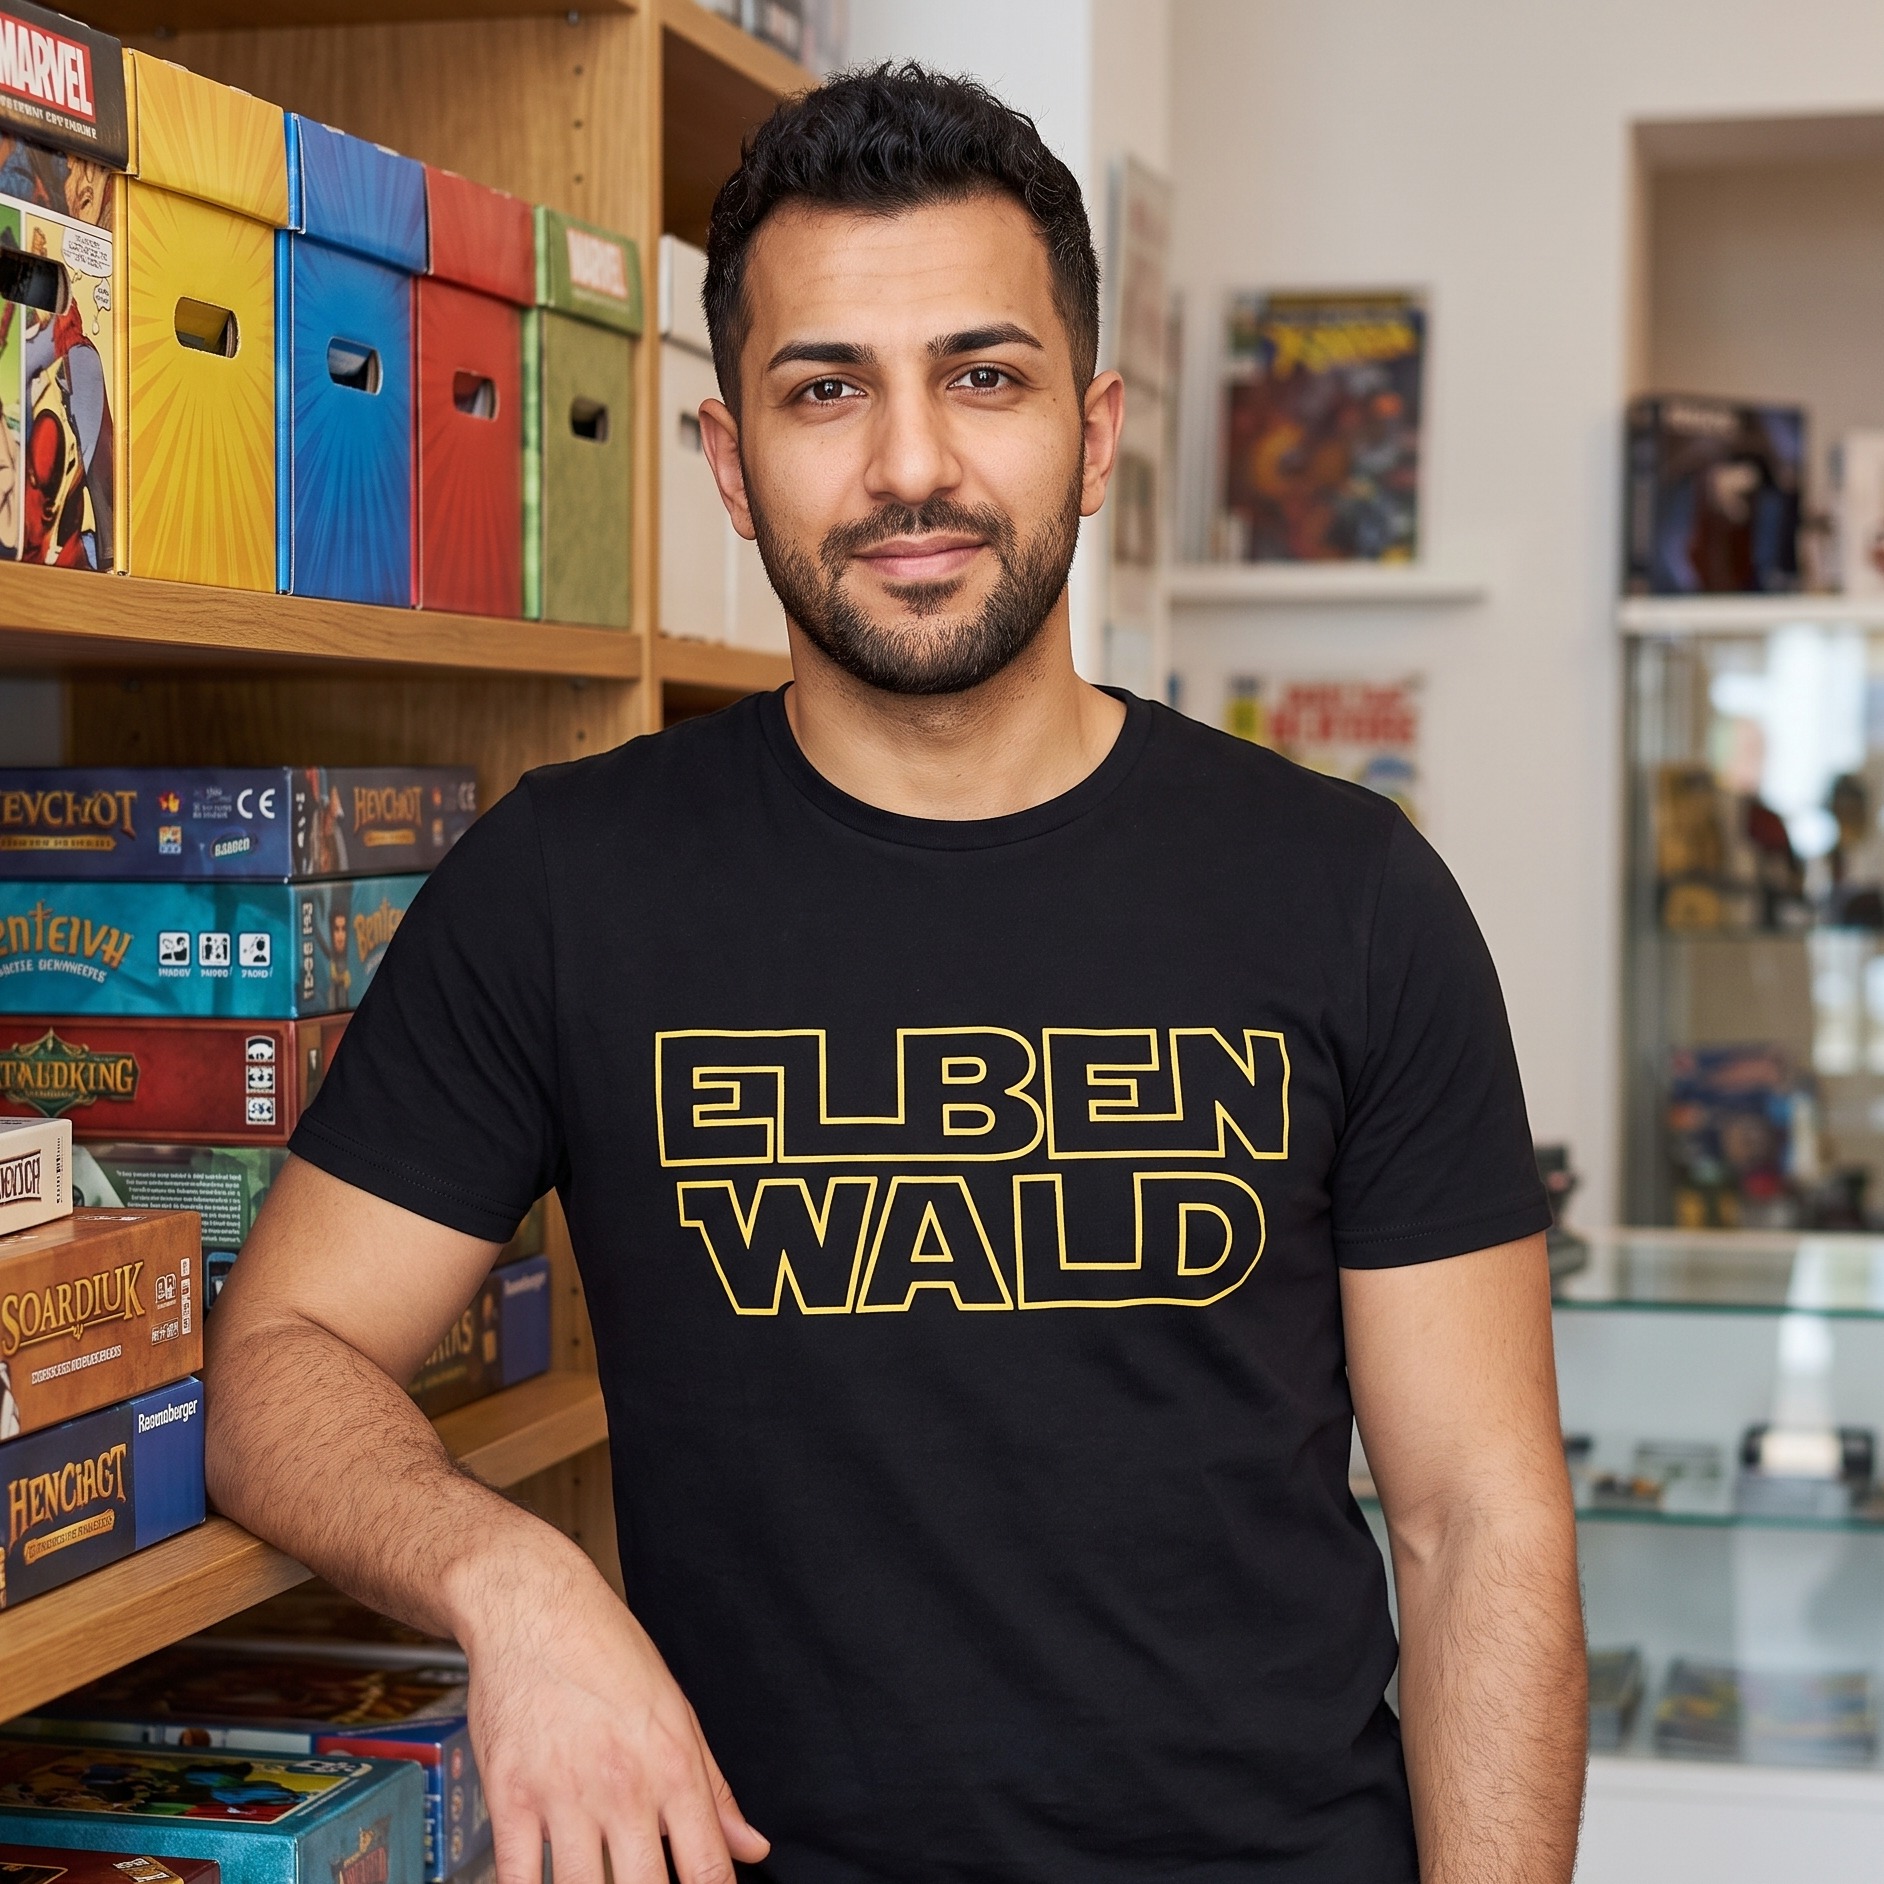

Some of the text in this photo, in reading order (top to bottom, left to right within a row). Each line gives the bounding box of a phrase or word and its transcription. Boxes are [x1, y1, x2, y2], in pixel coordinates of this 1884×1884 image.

[0, 17, 94, 117] MARVEL
[655, 1027, 1291, 1167] ELBEN
[677, 1172, 1267, 1315] WALD
